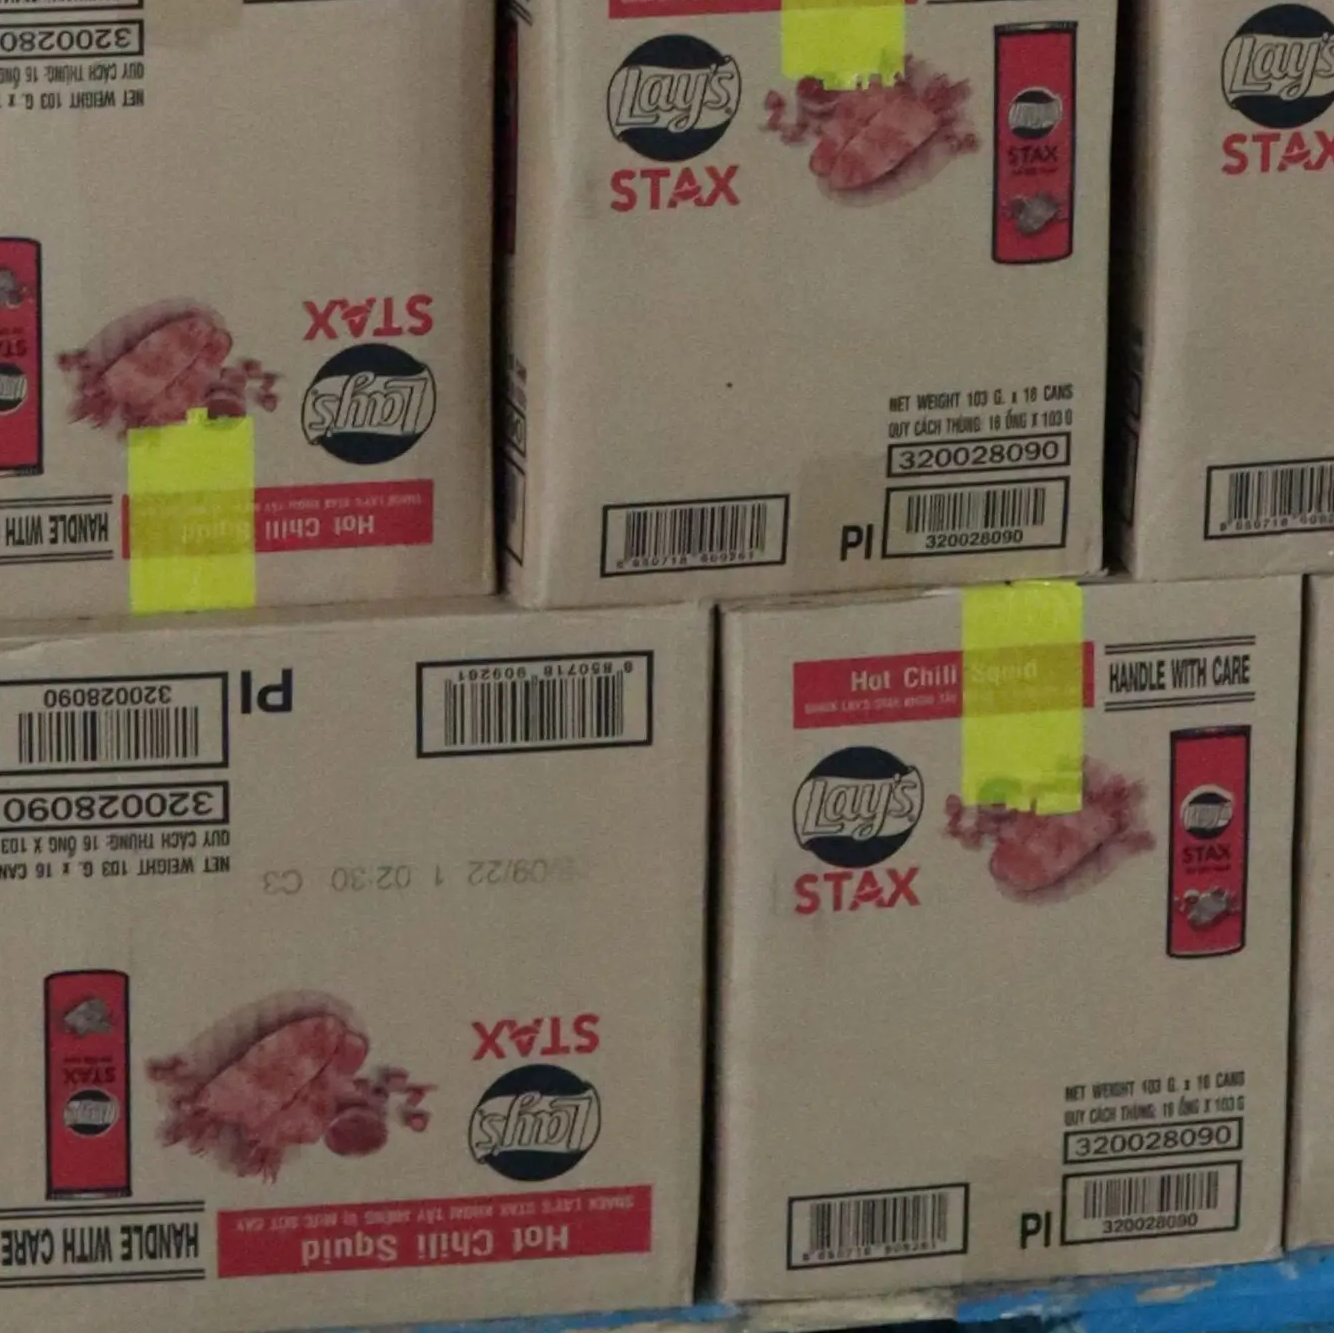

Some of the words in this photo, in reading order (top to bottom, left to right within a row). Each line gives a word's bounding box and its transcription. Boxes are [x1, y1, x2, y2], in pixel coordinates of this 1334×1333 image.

[612, 166, 737, 211] STAX
[307, 294, 433, 339] STAX
[899, 441, 1058, 470] 320028090
[4, 791, 213, 822] 320028090
[795, 868, 917, 914] STAX
[475, 1014, 599, 1058] STAX
[1076, 1126, 1231, 1156] 320028090
[1, 1229, 54, 1266] CARE
[63, 1227, 112, 1263] WITH
[121, 1223, 198, 1261] HANDLE
[302, 1231, 397, 1266] Squid
[418, 1230, 493, 1258] Chili
[514, 1225, 568, 1251] Hot
